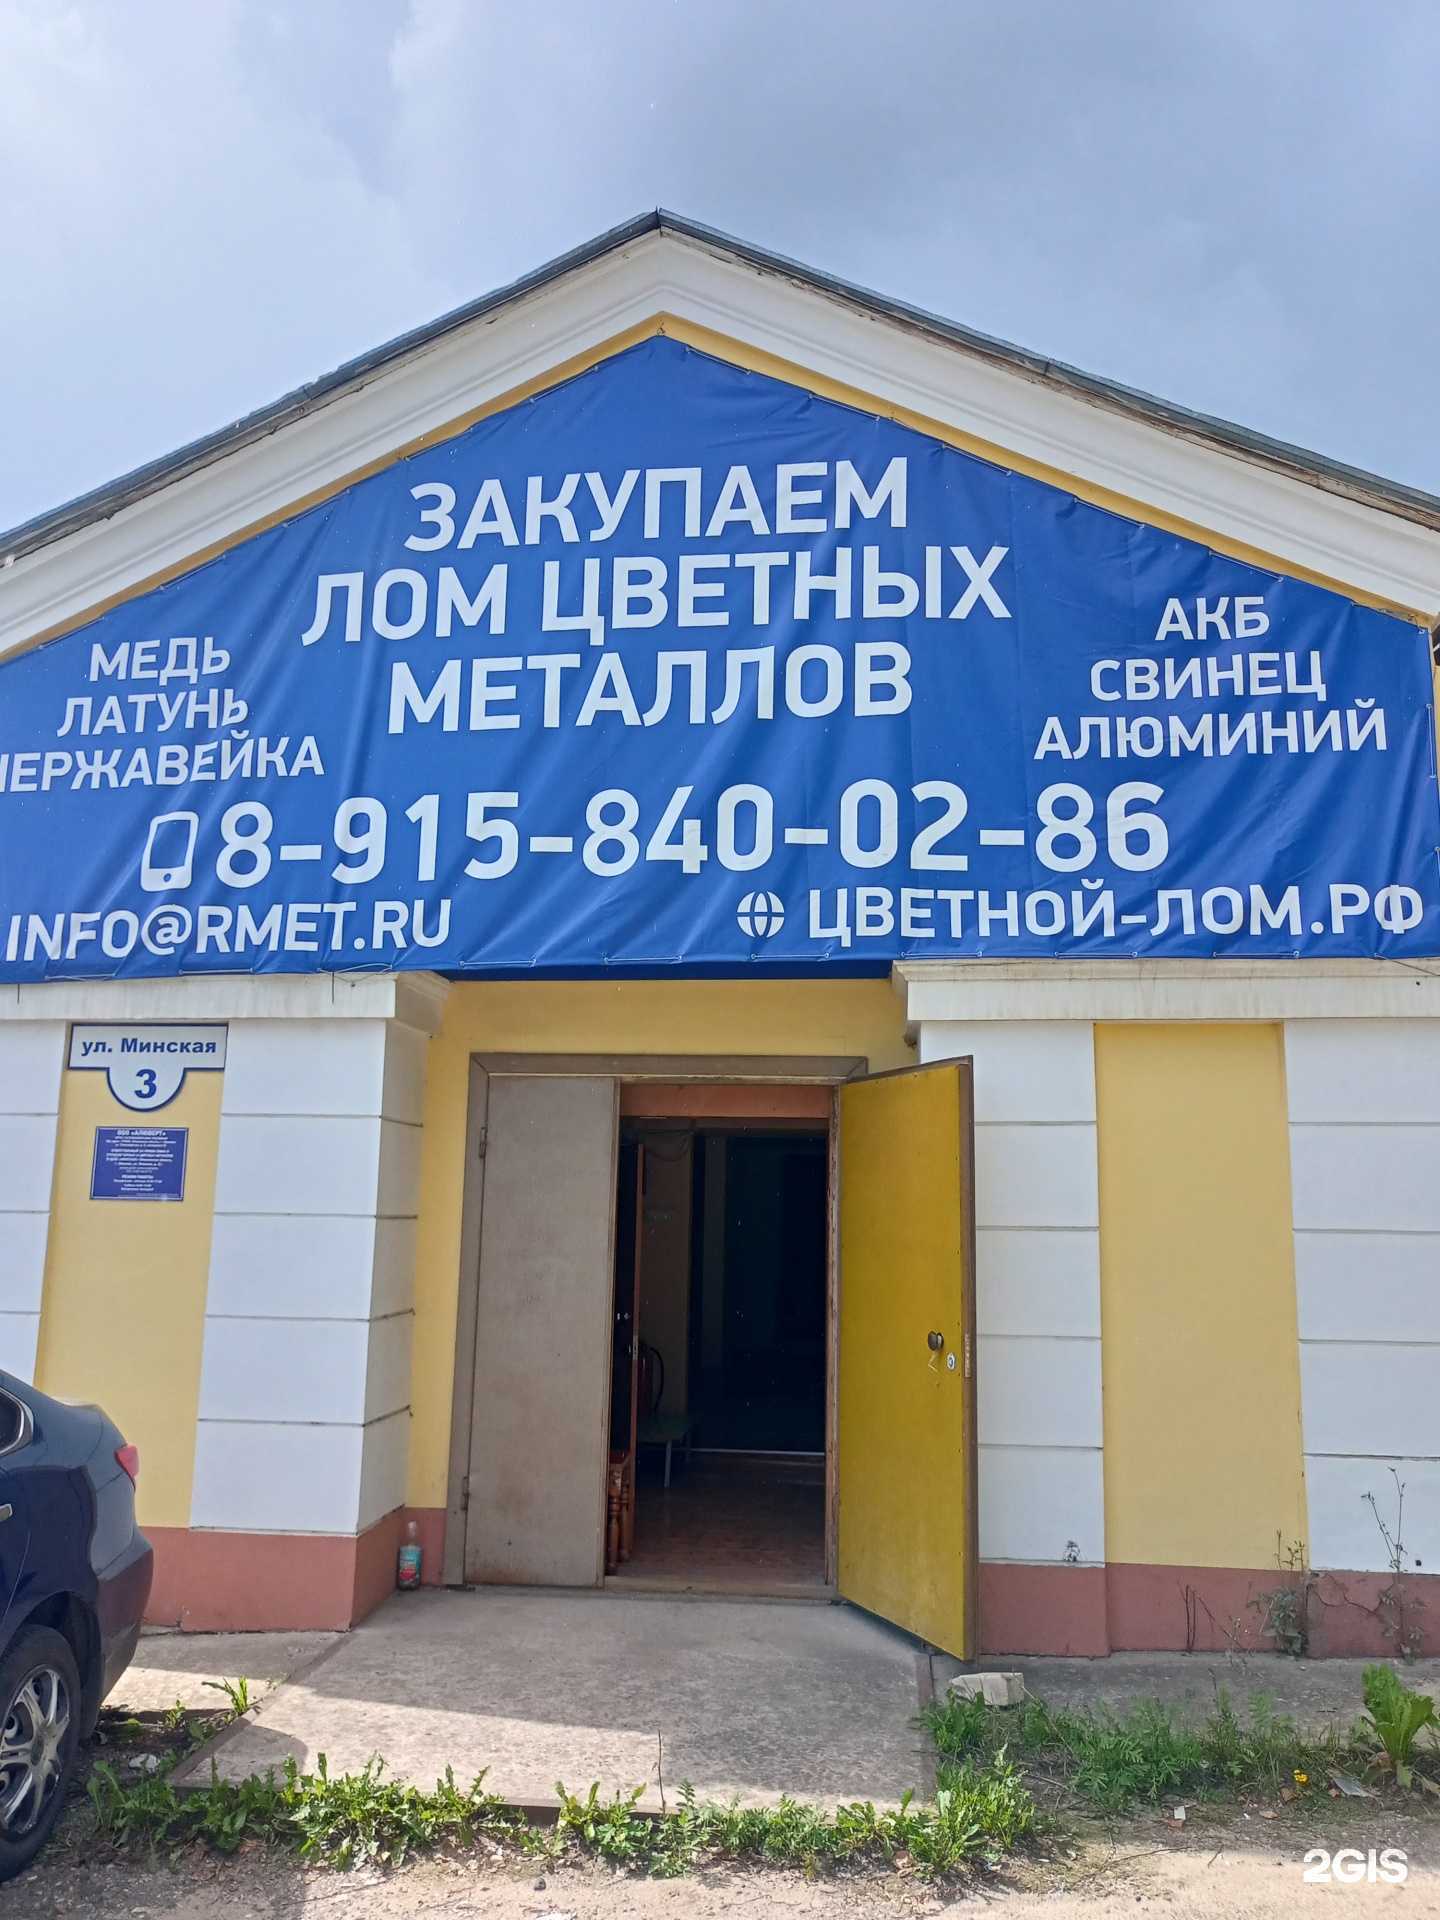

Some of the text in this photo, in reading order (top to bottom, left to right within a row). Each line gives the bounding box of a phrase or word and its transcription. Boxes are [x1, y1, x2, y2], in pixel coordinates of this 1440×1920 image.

[405, 457, 907, 552] ЗАКУПАЕМ
[302, 546, 1012, 646] ЛОМ ЦВЕТНЫХ
[1155, 596, 1270, 641] АКБ
[89, 637, 231, 686] МЕДЬ
[388, 641, 913, 734] МЕТАЛЛОВ
[1090, 651, 1327, 701] СВИНЕЦ
[57, 687, 248, 737] ЛАТУНЬ
[1034, 698, 1387, 760] АЛЮМИНИЙ
[216, 779, 1169, 888] 8-915-840-02-86
[6, 900, 451, 962] INFO@RMET.RU
[809, 878, 1424, 947] ЦВЕТНОЙ-ЛОМ.РФ
[81, 1038, 217, 1057] ул. Минская
[134, 1068, 158, 1099] 3
